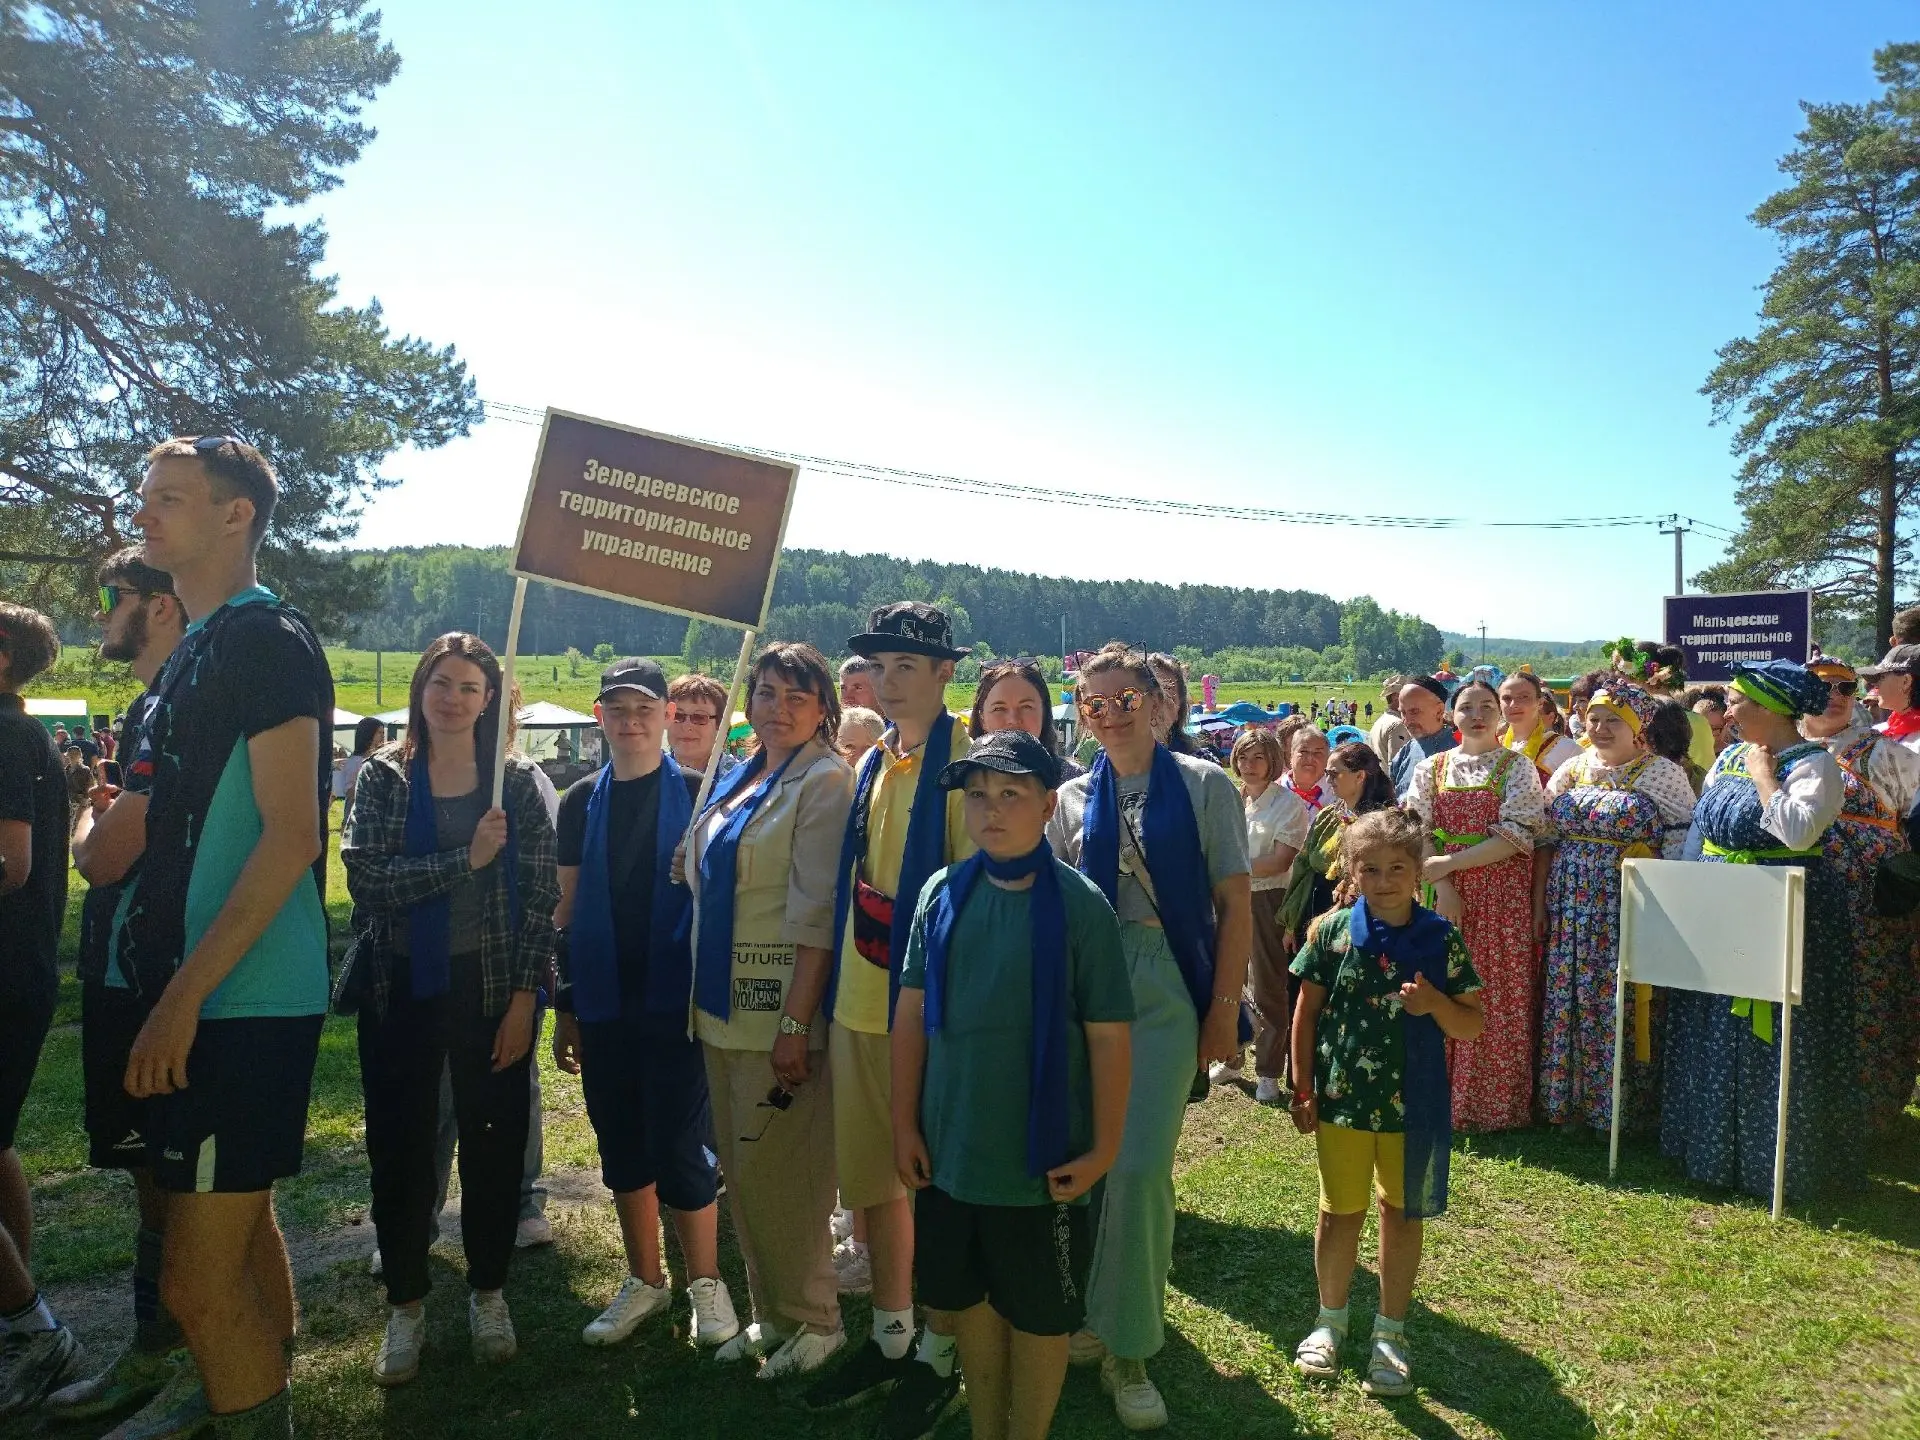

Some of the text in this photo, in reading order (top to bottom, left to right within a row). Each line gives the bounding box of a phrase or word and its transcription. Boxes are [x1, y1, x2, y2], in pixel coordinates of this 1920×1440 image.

[583, 458, 740, 515] Зеледеевское
[559, 489, 752, 551] территориальное
[581, 528, 713, 576] управление
[1692, 614, 1779, 628] Мальцевское
[1680, 631, 1793, 646] территориальное
[1697, 650, 1772, 664] управление
[731, 951, 794, 966] FUTURE
